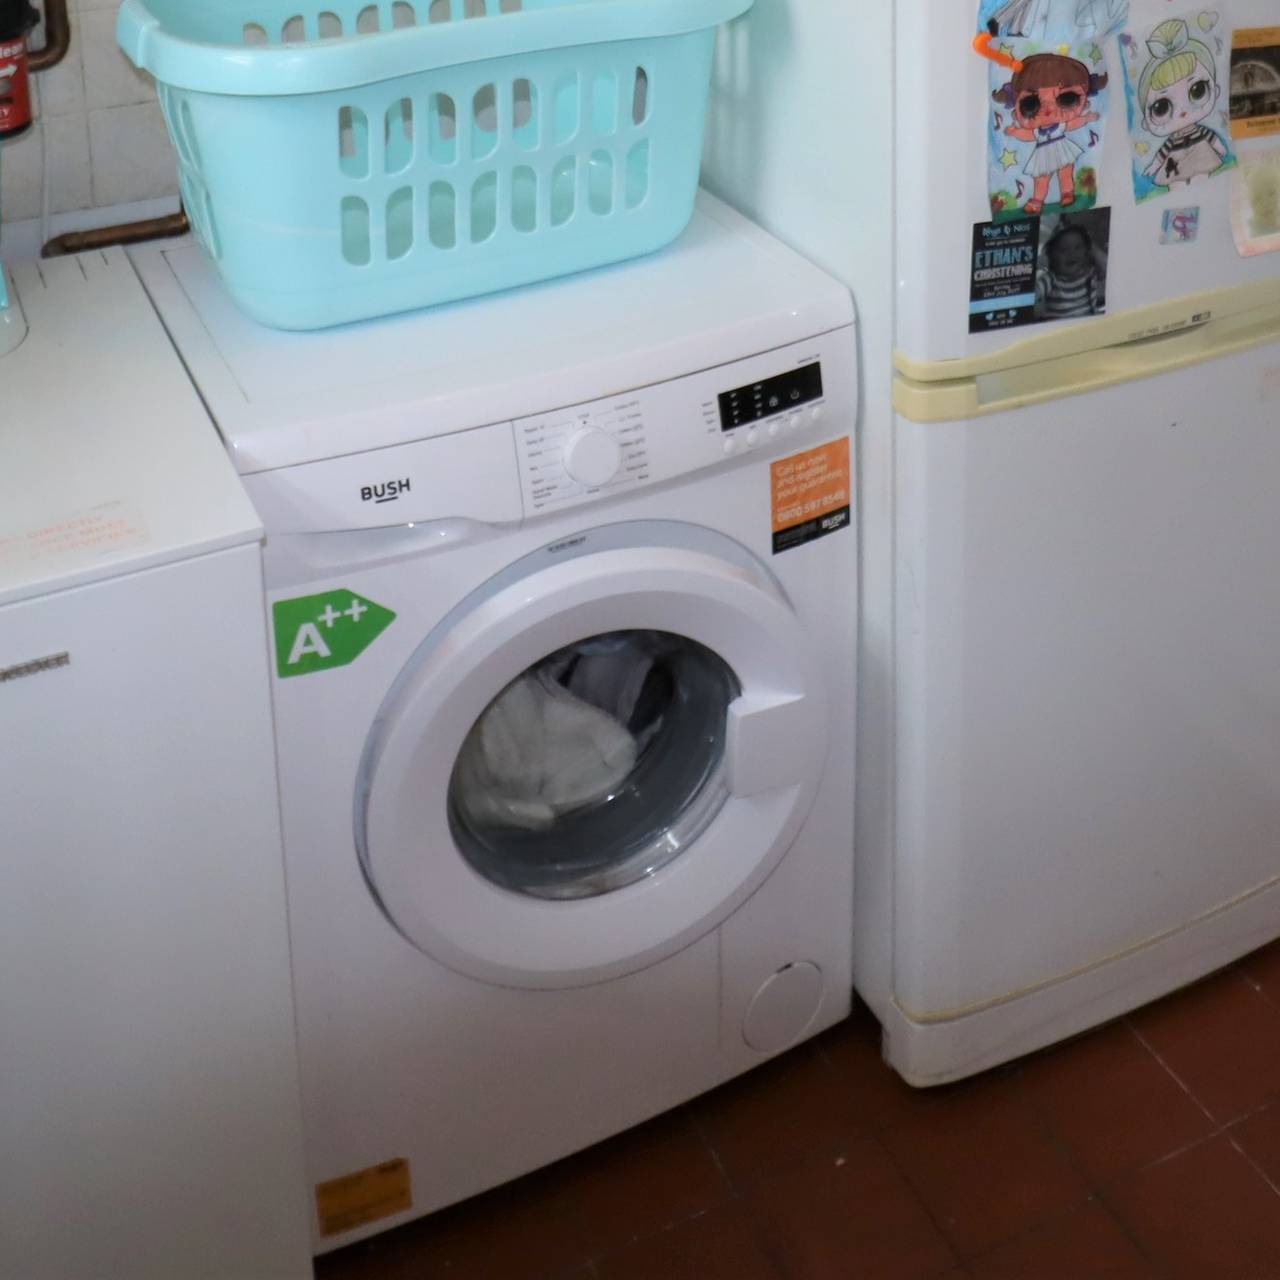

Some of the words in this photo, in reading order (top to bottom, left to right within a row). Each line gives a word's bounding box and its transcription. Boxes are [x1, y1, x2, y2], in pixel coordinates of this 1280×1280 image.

[975, 246, 1034, 269] ETHAN'S
[974, 263, 1033, 281] CHRISTENING
[360, 477, 411, 502] BUSH
[821, 512, 846, 530] BUSH
[286, 598, 369, 665] A++
